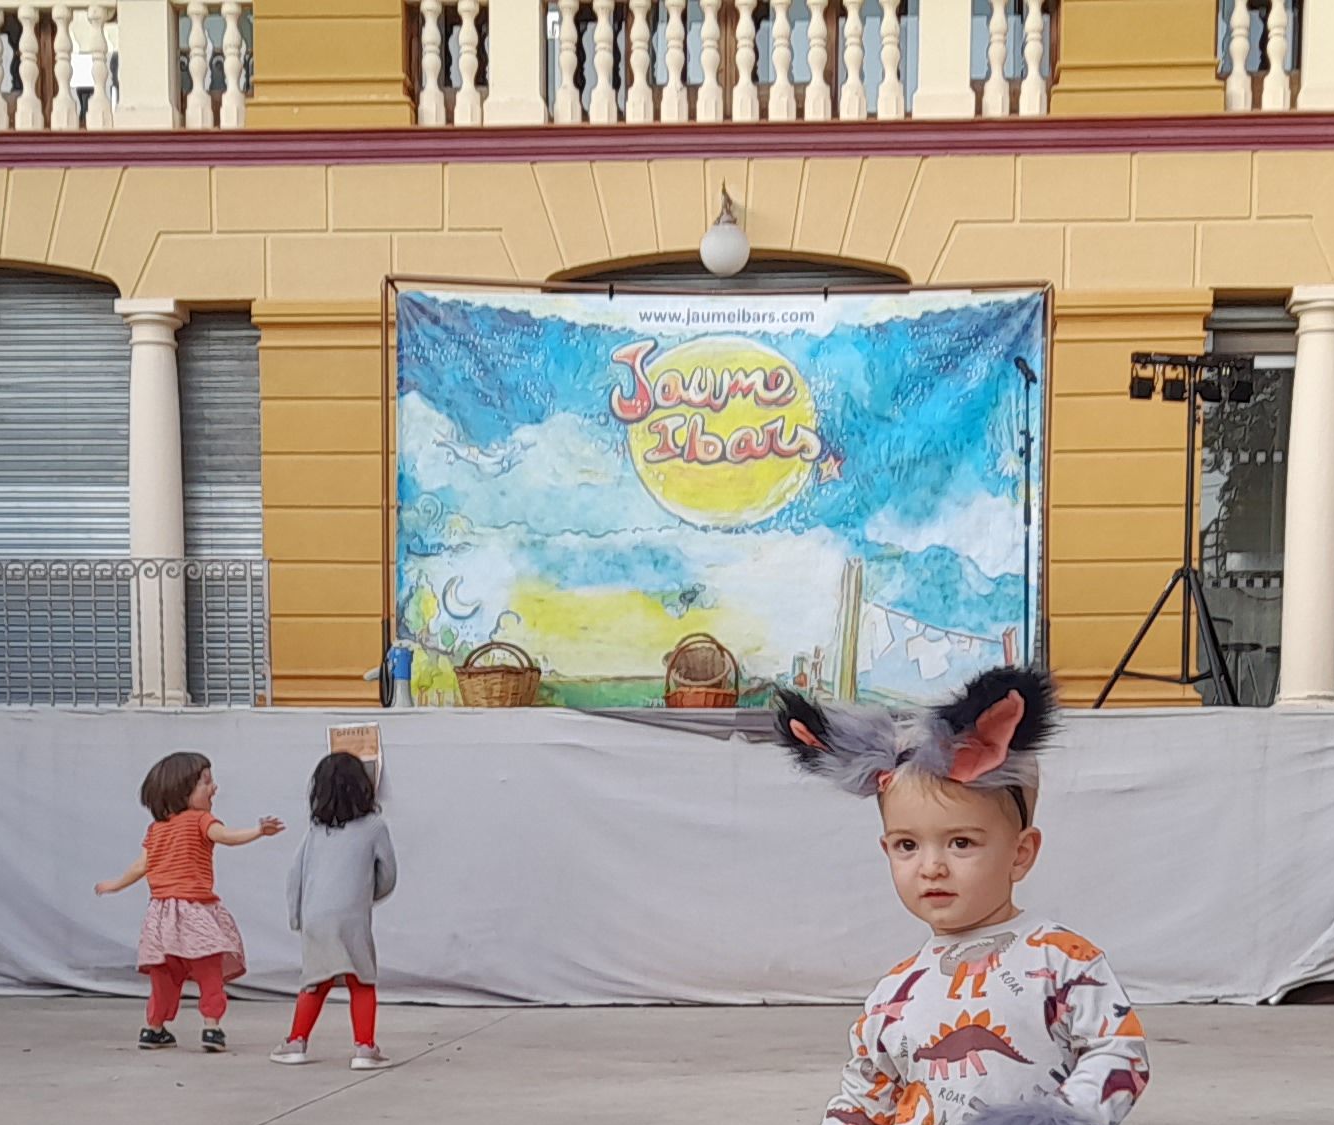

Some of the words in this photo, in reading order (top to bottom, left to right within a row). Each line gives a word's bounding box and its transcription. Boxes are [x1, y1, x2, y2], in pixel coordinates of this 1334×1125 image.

[610, 338, 797, 421] Jaume
[643, 412, 822, 465] Ibars
[998, 970, 1024, 997] ROAR
[938, 1087, 966, 1105] ROAR
